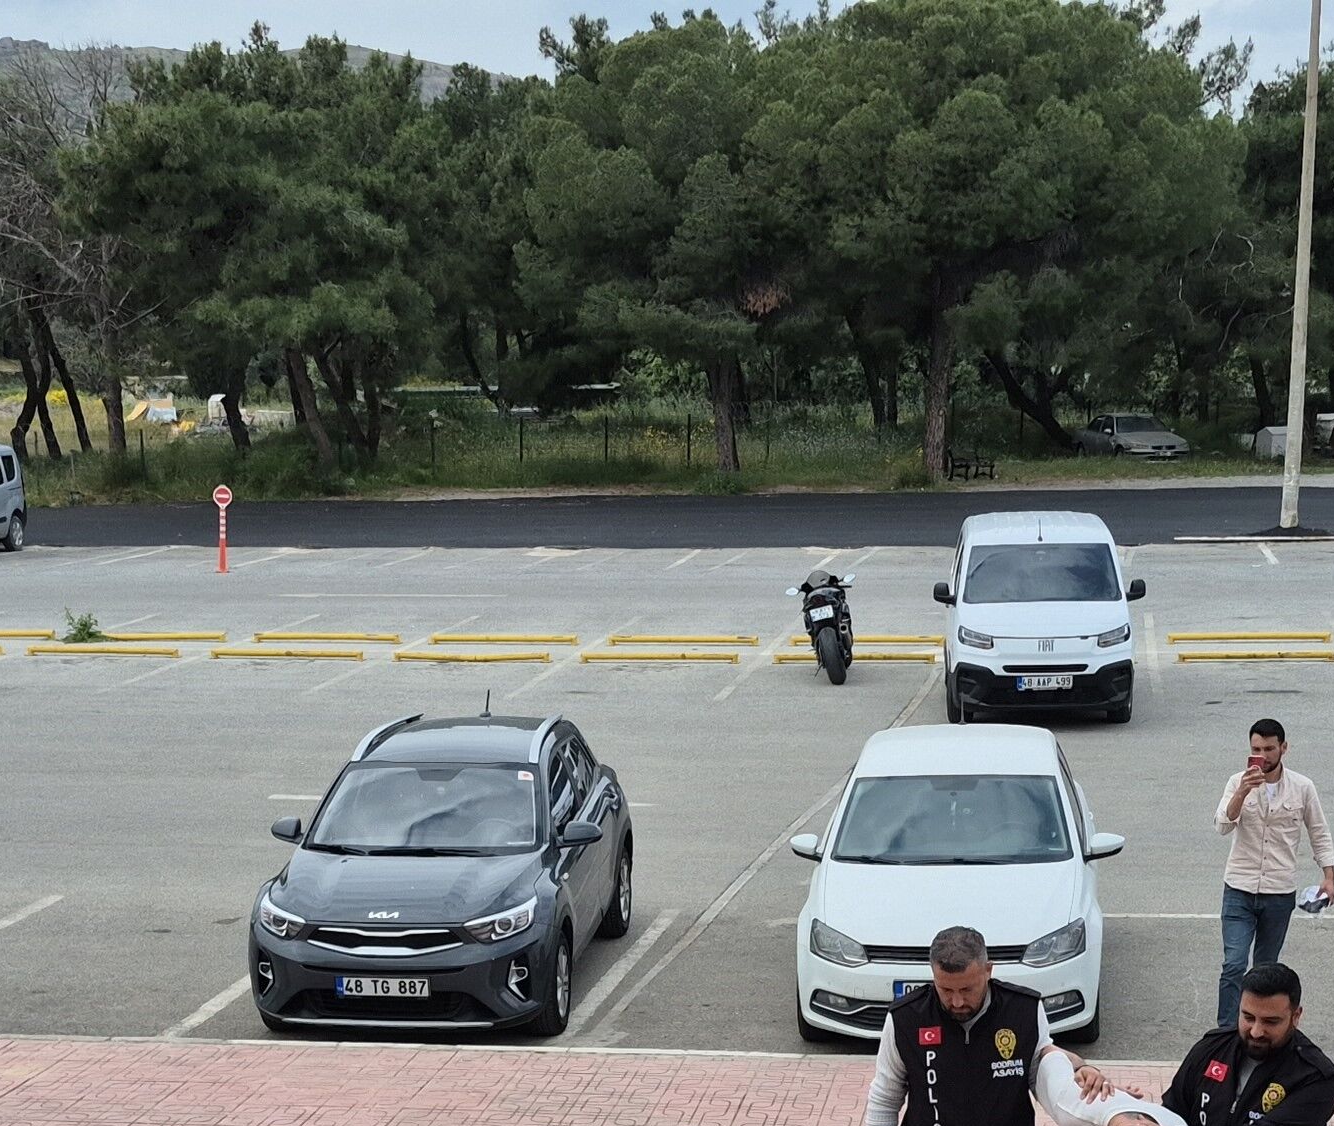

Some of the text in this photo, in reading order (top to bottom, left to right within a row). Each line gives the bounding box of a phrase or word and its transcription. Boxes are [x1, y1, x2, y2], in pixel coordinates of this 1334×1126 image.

[1037, 640, 1055, 652] FIAT
[345, 979, 427, 995] 48 TG 887
[991, 1059, 1024, 1070] BODRUM
